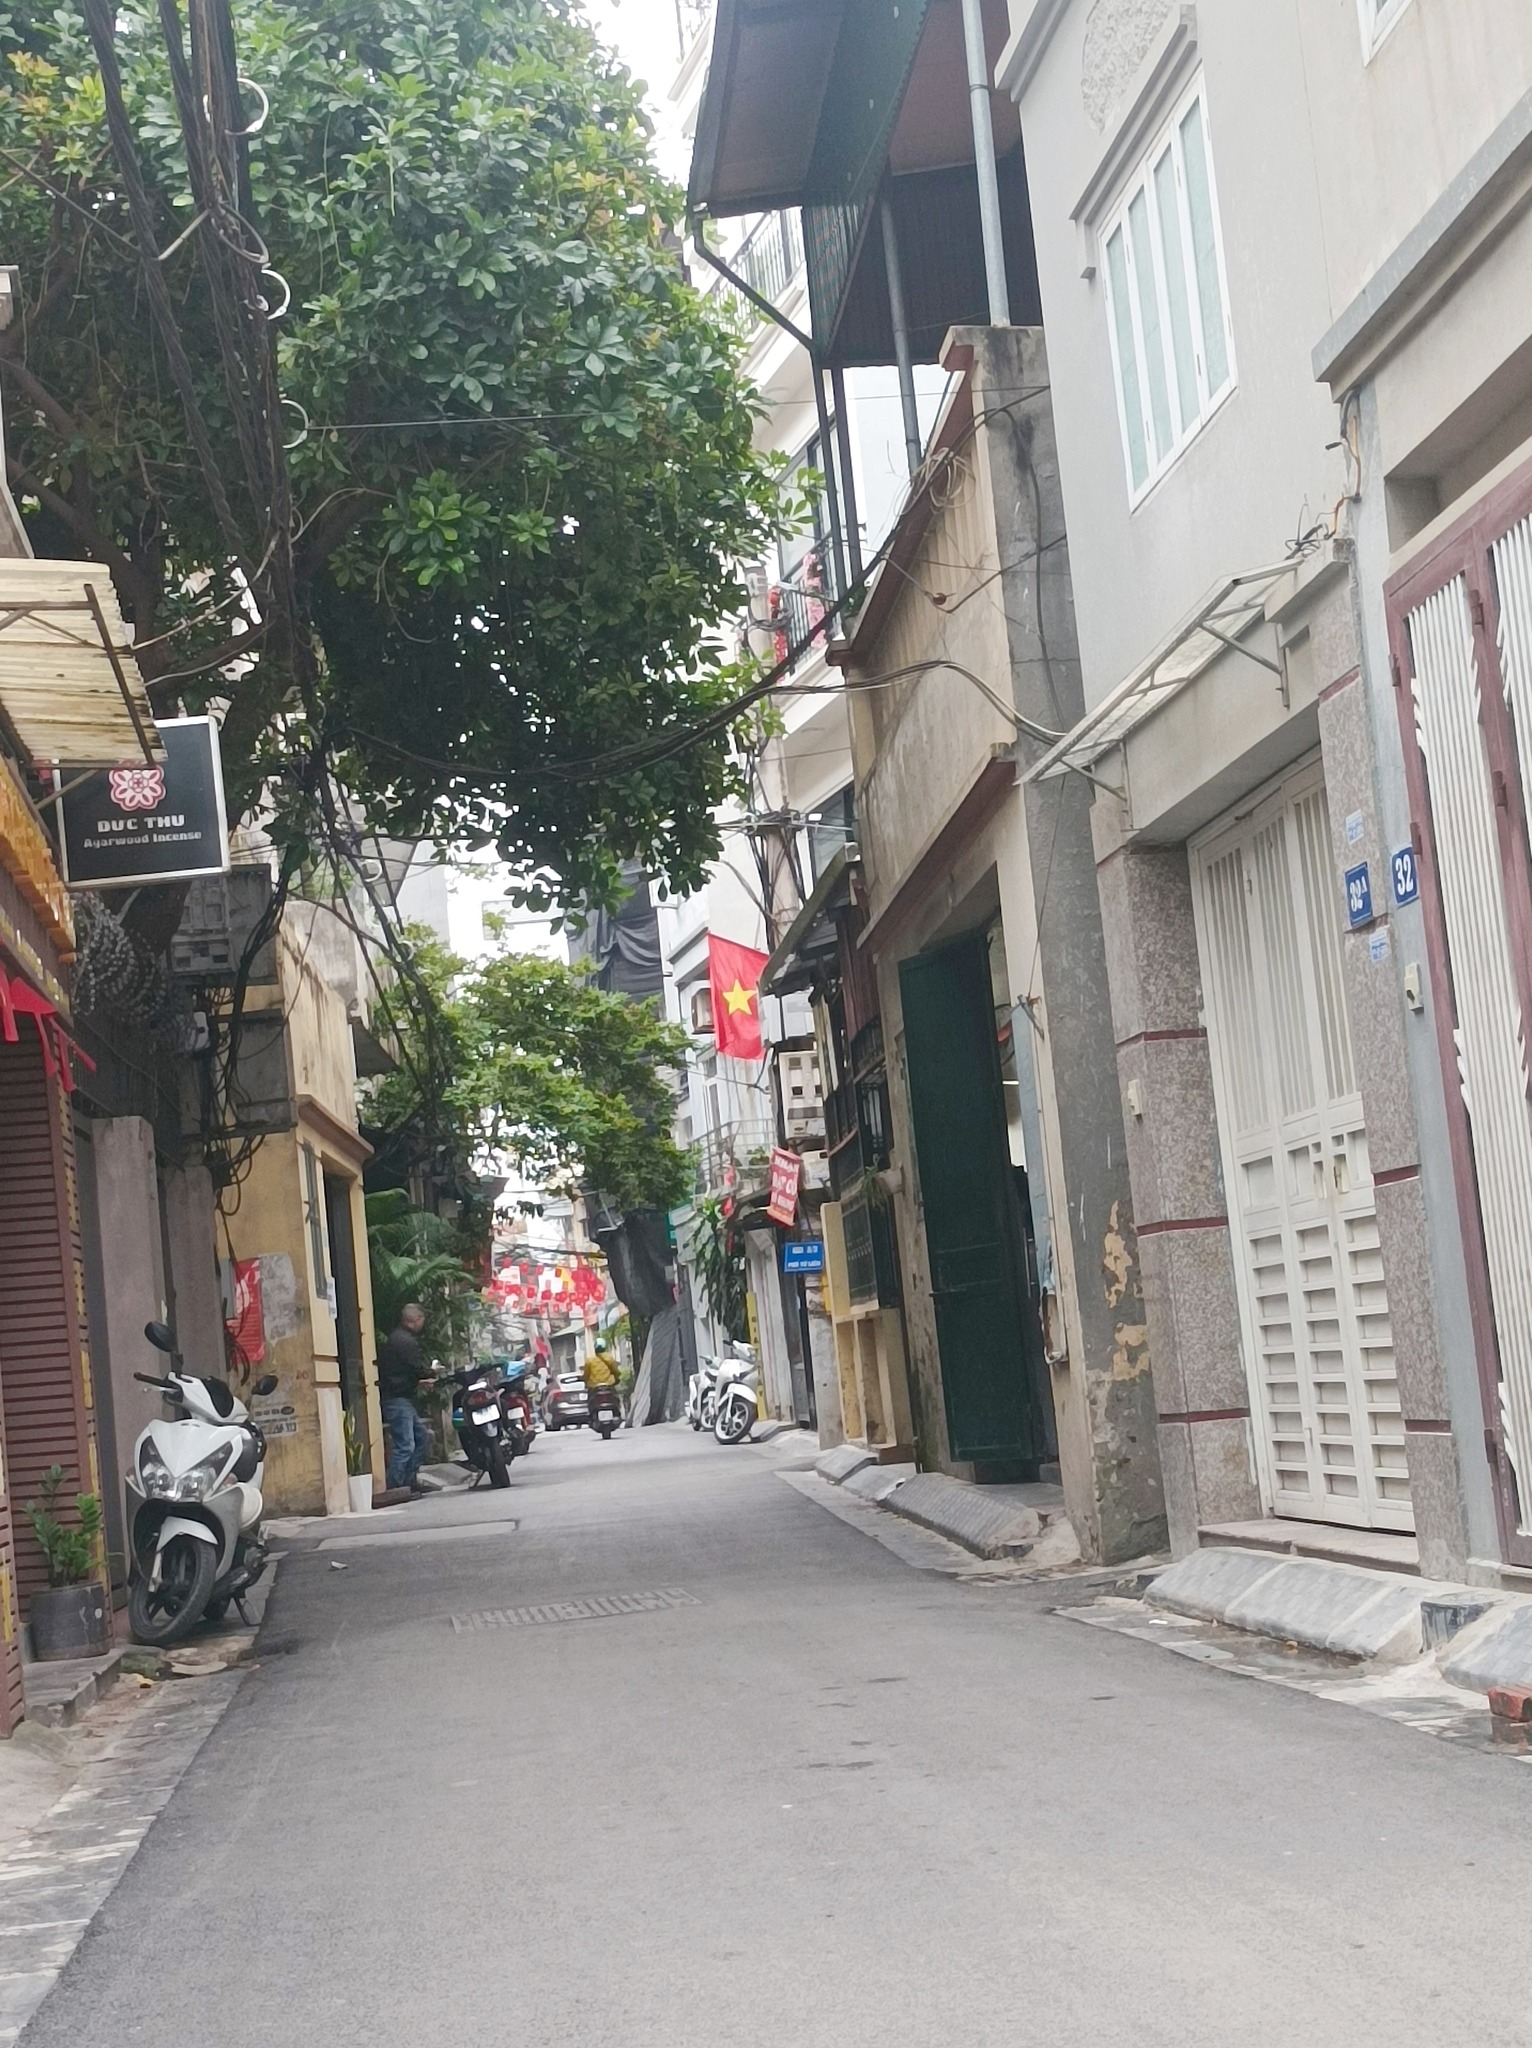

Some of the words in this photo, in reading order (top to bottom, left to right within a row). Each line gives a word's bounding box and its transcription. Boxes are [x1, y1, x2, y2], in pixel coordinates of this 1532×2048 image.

[144, 814, 185, 829] THU
[83, 834, 150, 849] Agarwood
[152, 831, 202, 843] Incense
[1395, 854, 1414, 896] 32
[1349, 875, 1368, 912] 32A
